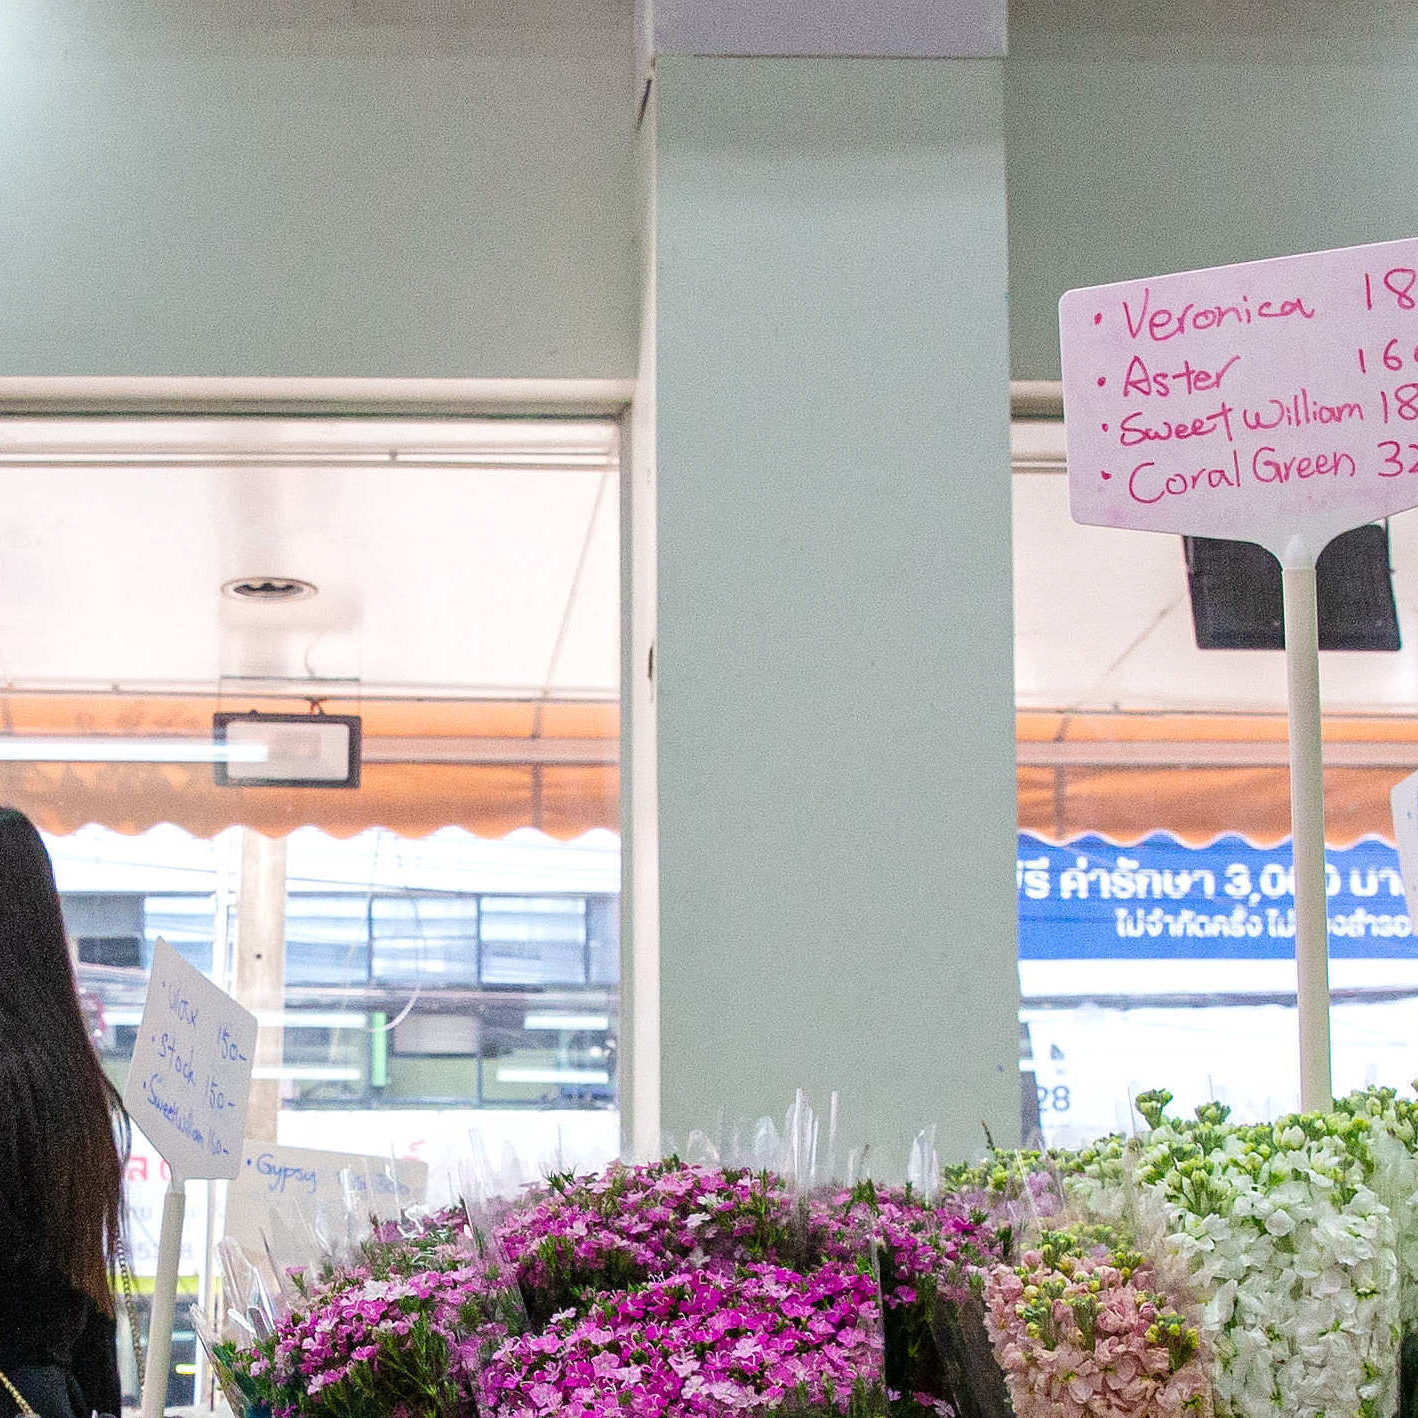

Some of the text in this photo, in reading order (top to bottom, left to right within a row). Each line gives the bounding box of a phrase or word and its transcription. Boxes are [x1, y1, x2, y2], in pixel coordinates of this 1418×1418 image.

[1122, 287, 1315, 342] Veronica
[1122, 354, 1241, 397] Aster
[1119, 402, 1234, 447] Sweet
[1129, 449, 1241, 503] Coral
[1252, 446, 1356, 484] Green
[1016, 856, 1050, 899] รี
[1060, 856, 1216, 899] ค่ารักษา
[1224, 863, 1342, 907] 3,00
[257, 1153, 318, 1195] Gypsy
